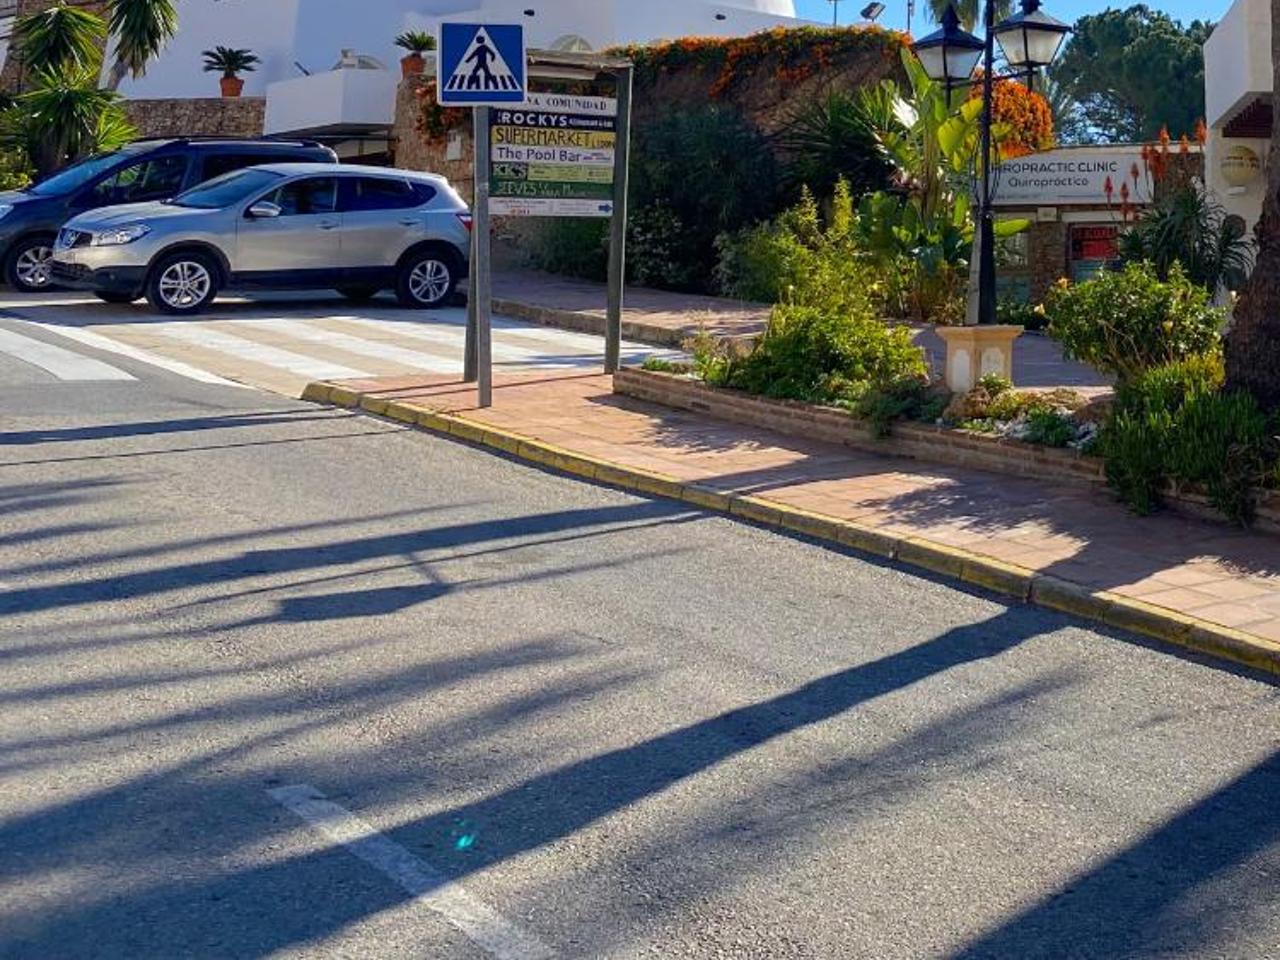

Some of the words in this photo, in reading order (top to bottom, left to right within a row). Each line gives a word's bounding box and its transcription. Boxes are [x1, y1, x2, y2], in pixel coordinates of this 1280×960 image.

[546, 98, 607, 111] COMUNIDAD
[501, 112, 567, 127] ROCKYS
[496, 127, 592, 147] SUPERMARKET
[497, 147, 522, 159] The
[526, 148, 556, 160] Pool
[559, 151, 581, 162] Bar
[1078, 161, 1117, 173] CLINIC
